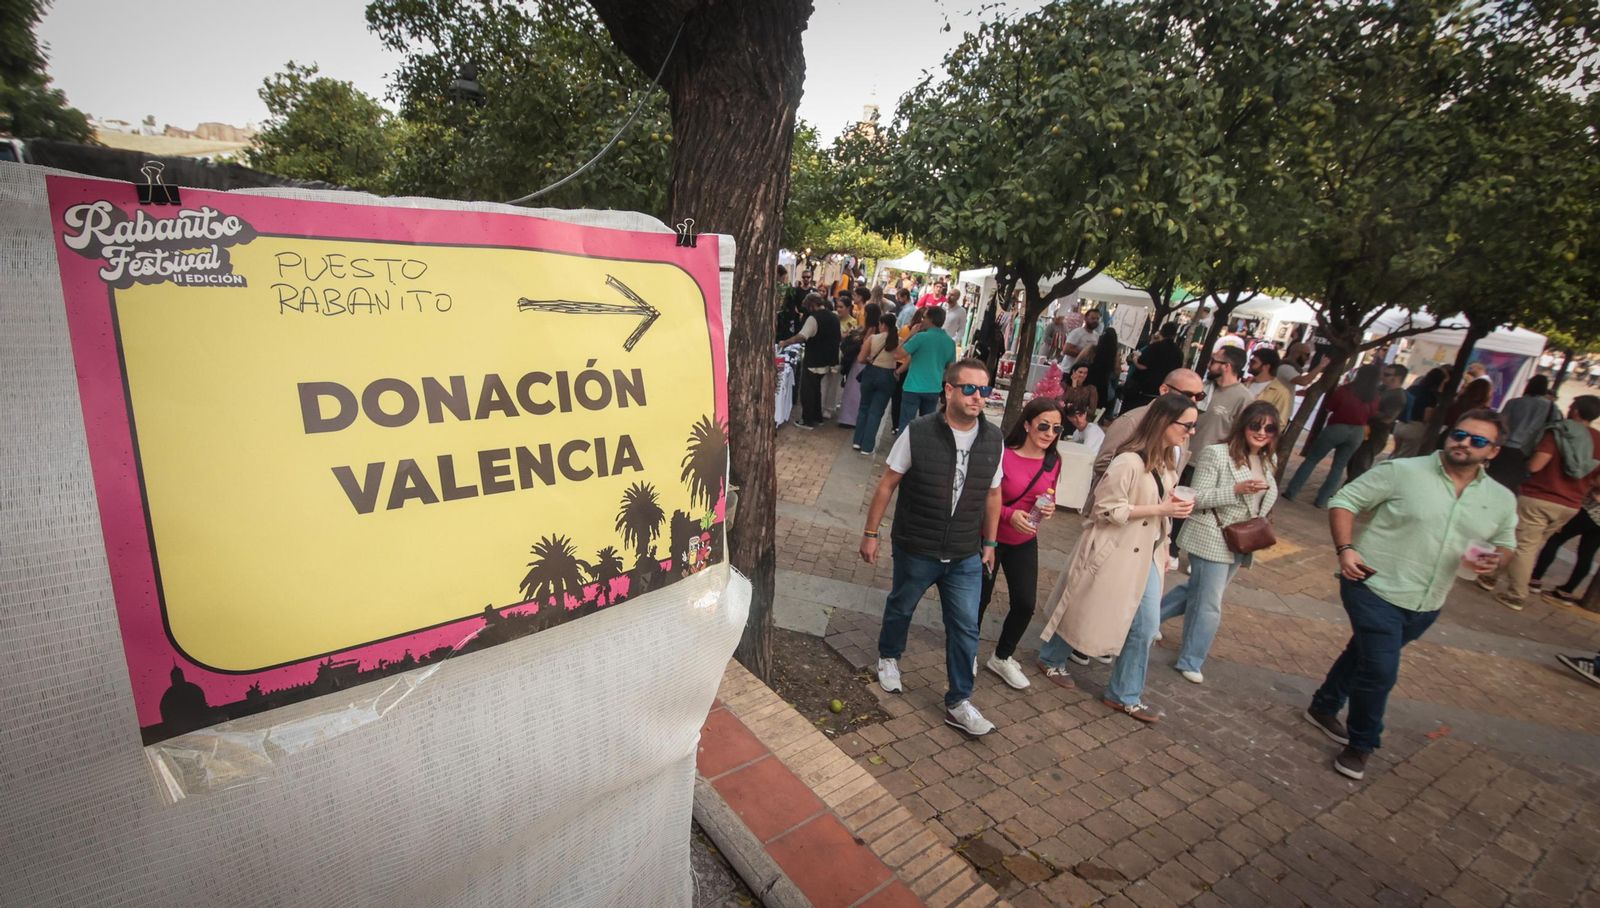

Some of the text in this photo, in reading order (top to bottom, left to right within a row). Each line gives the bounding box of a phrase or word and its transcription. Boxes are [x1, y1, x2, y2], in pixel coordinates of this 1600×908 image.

[64, 200, 242, 249] Rabanito
[100, 244, 221, 281] Festival
[173, 272, 243, 284] II EDICIÓN
[274, 252, 428, 285] PUESTO
[271, 283, 452, 316] RABANITO
[297, 358, 647, 434] DONACIÓN
[331, 434, 645, 515] VALENCIA
